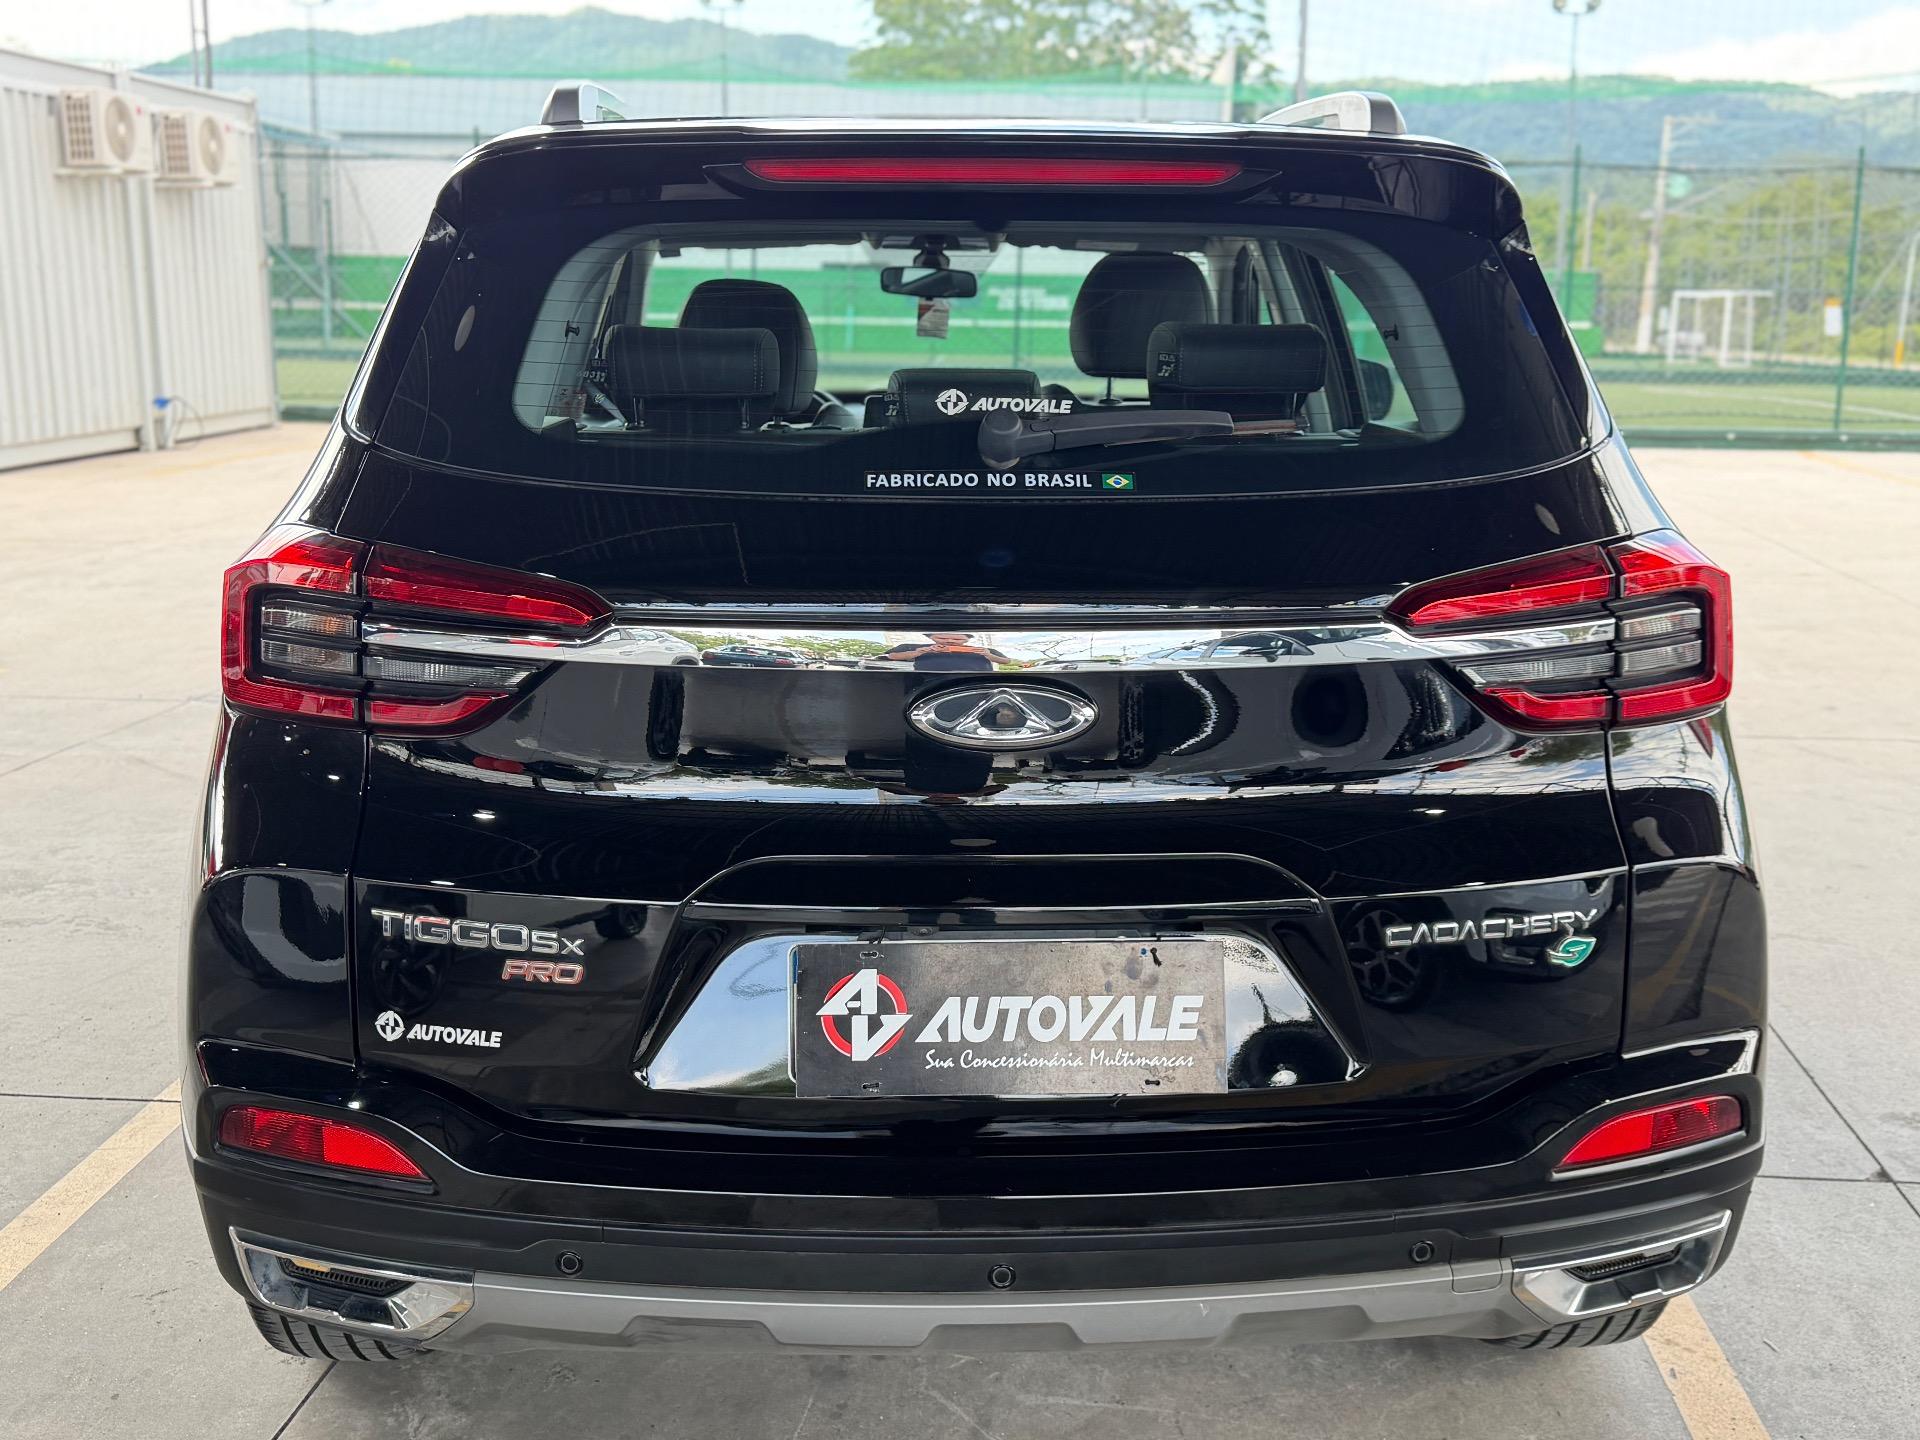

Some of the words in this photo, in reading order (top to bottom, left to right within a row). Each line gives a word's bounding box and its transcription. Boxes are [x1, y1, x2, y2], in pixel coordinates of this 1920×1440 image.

[970, 397, 1073, 414] AUTOVALE
[866, 473, 979, 488] FABRICADO
[987, 473, 1017, 487] NO
[1024, 473, 1093, 488] BRASIL
[502, 959, 584, 984] PRO
[914, 995, 1205, 1042] AUTOVALE
[406, 1023, 503, 1048] AUTOVALE
[924, 1049, 955, 1070] Sua
[960, 1049, 1083, 1069] Concessionária
[1090, 1049, 1195, 1068] Multimarcas
